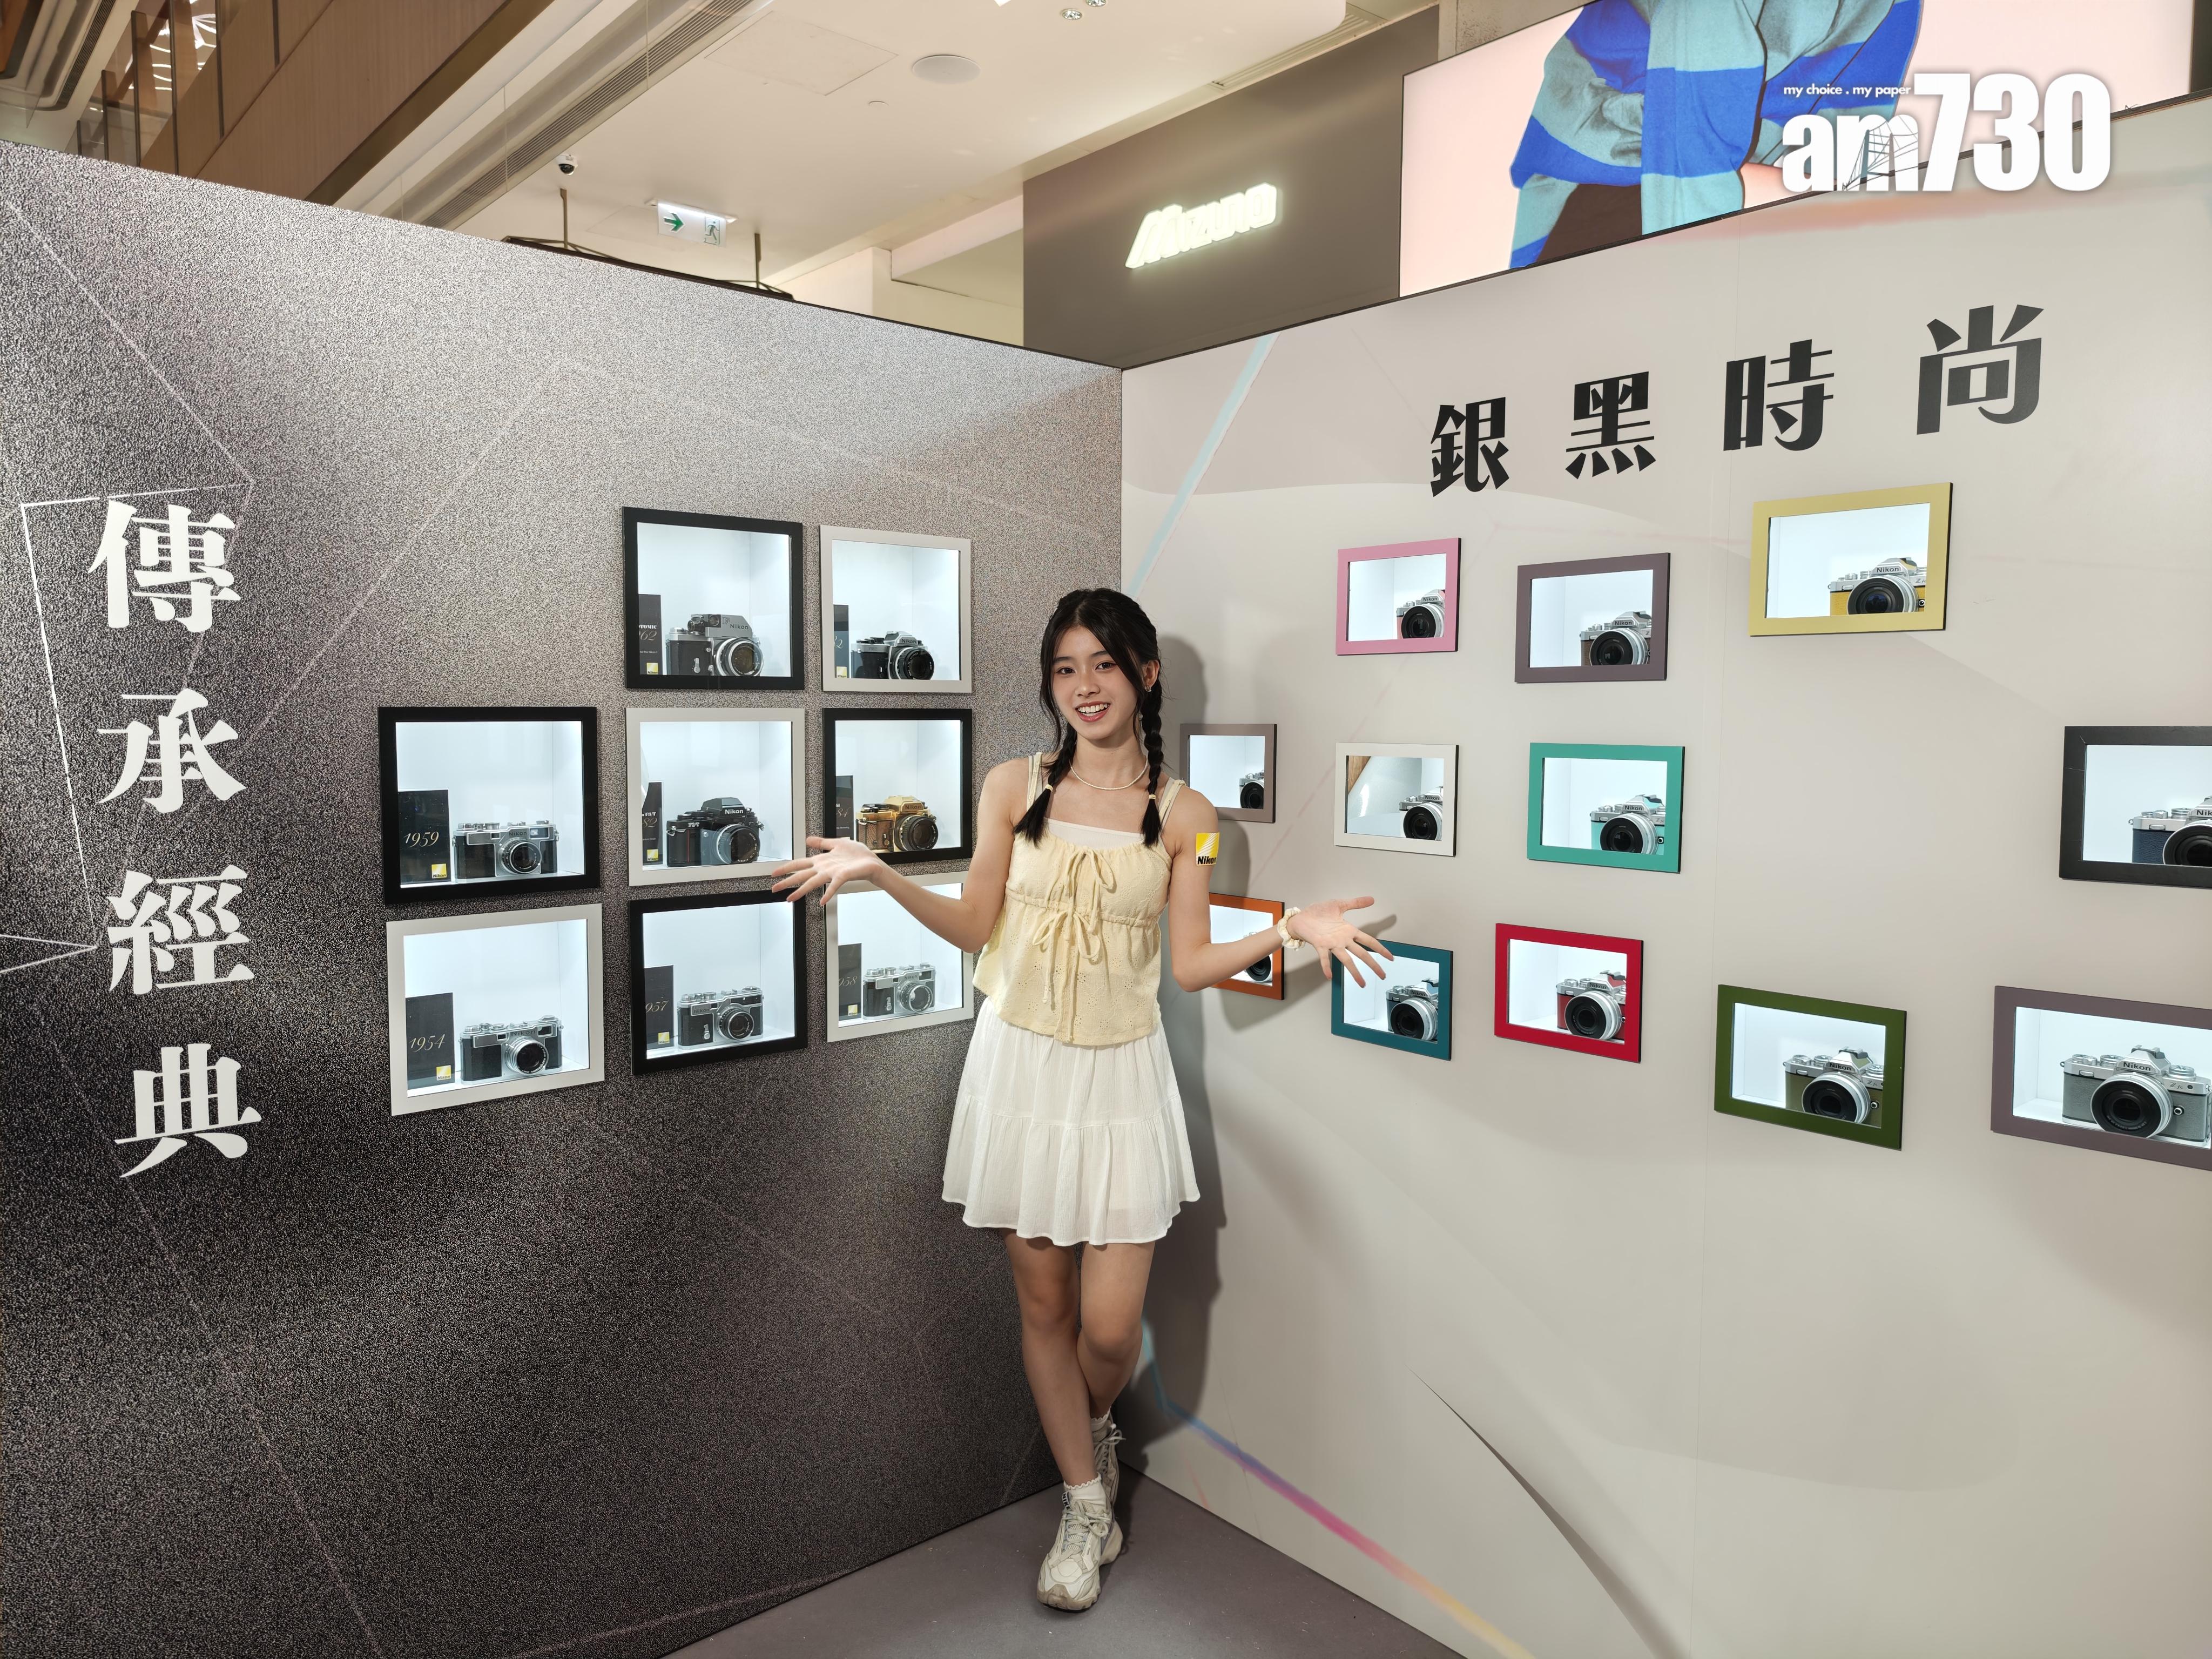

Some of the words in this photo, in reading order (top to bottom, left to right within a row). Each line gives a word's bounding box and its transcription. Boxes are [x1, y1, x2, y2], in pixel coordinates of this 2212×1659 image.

[1430, 304, 2045, 497] 銀黑時尚
[639, 630, 657, 641] 62
[88, 500, 262, 1178] 傳承經典
[403, 831, 439, 848] 1959
[1197, 856, 1217, 865] Nikon
[409, 1034, 446, 1053] 1954
[1829, 1063, 1851, 1071] Nikon
[2123, 1062, 2151, 1071] Nikon
